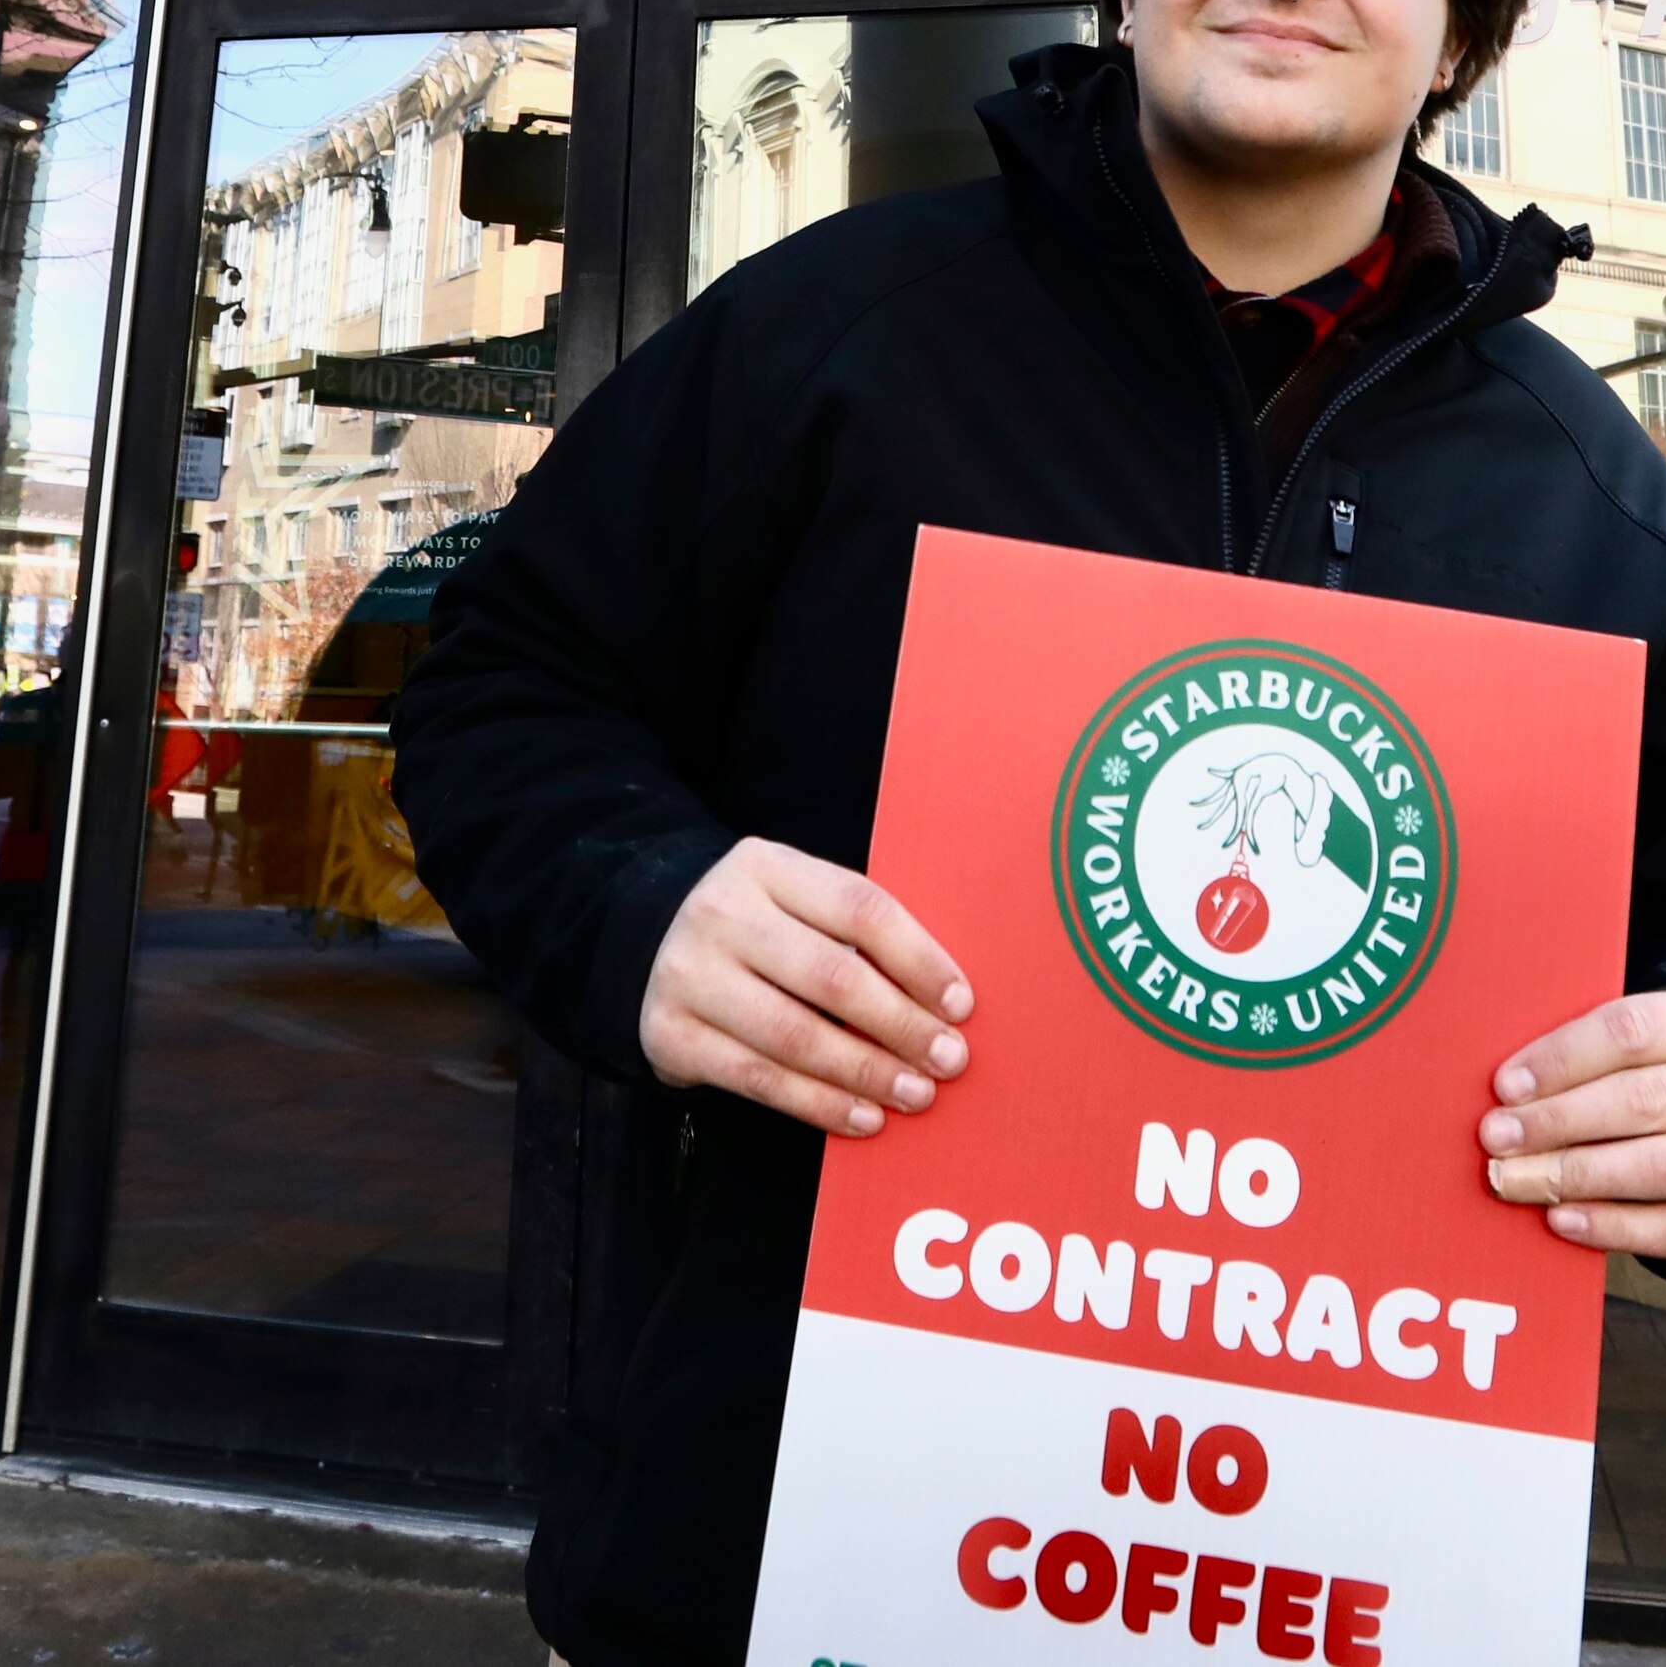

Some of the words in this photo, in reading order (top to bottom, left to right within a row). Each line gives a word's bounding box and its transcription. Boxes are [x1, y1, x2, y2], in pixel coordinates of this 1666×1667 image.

[388, 510, 434, 524] WAYS
[439, 511, 462, 524] TO
[468, 512, 501, 525] PAY
[408, 536, 455, 549] WAYS
[460, 537, 481, 549] TO
[1121, 669, 1415, 801] STARBUCKS
[1083, 793, 1242, 1032] WORKERS
[1284, 844, 1427, 1032] UNITED
[1134, 1121, 1301, 1229] NO
[892, 1207, 1518, 1392] CONTRACT
[1100, 1406, 1270, 1518] NO
[956, 1516, 1391, 1667] COFFEE
